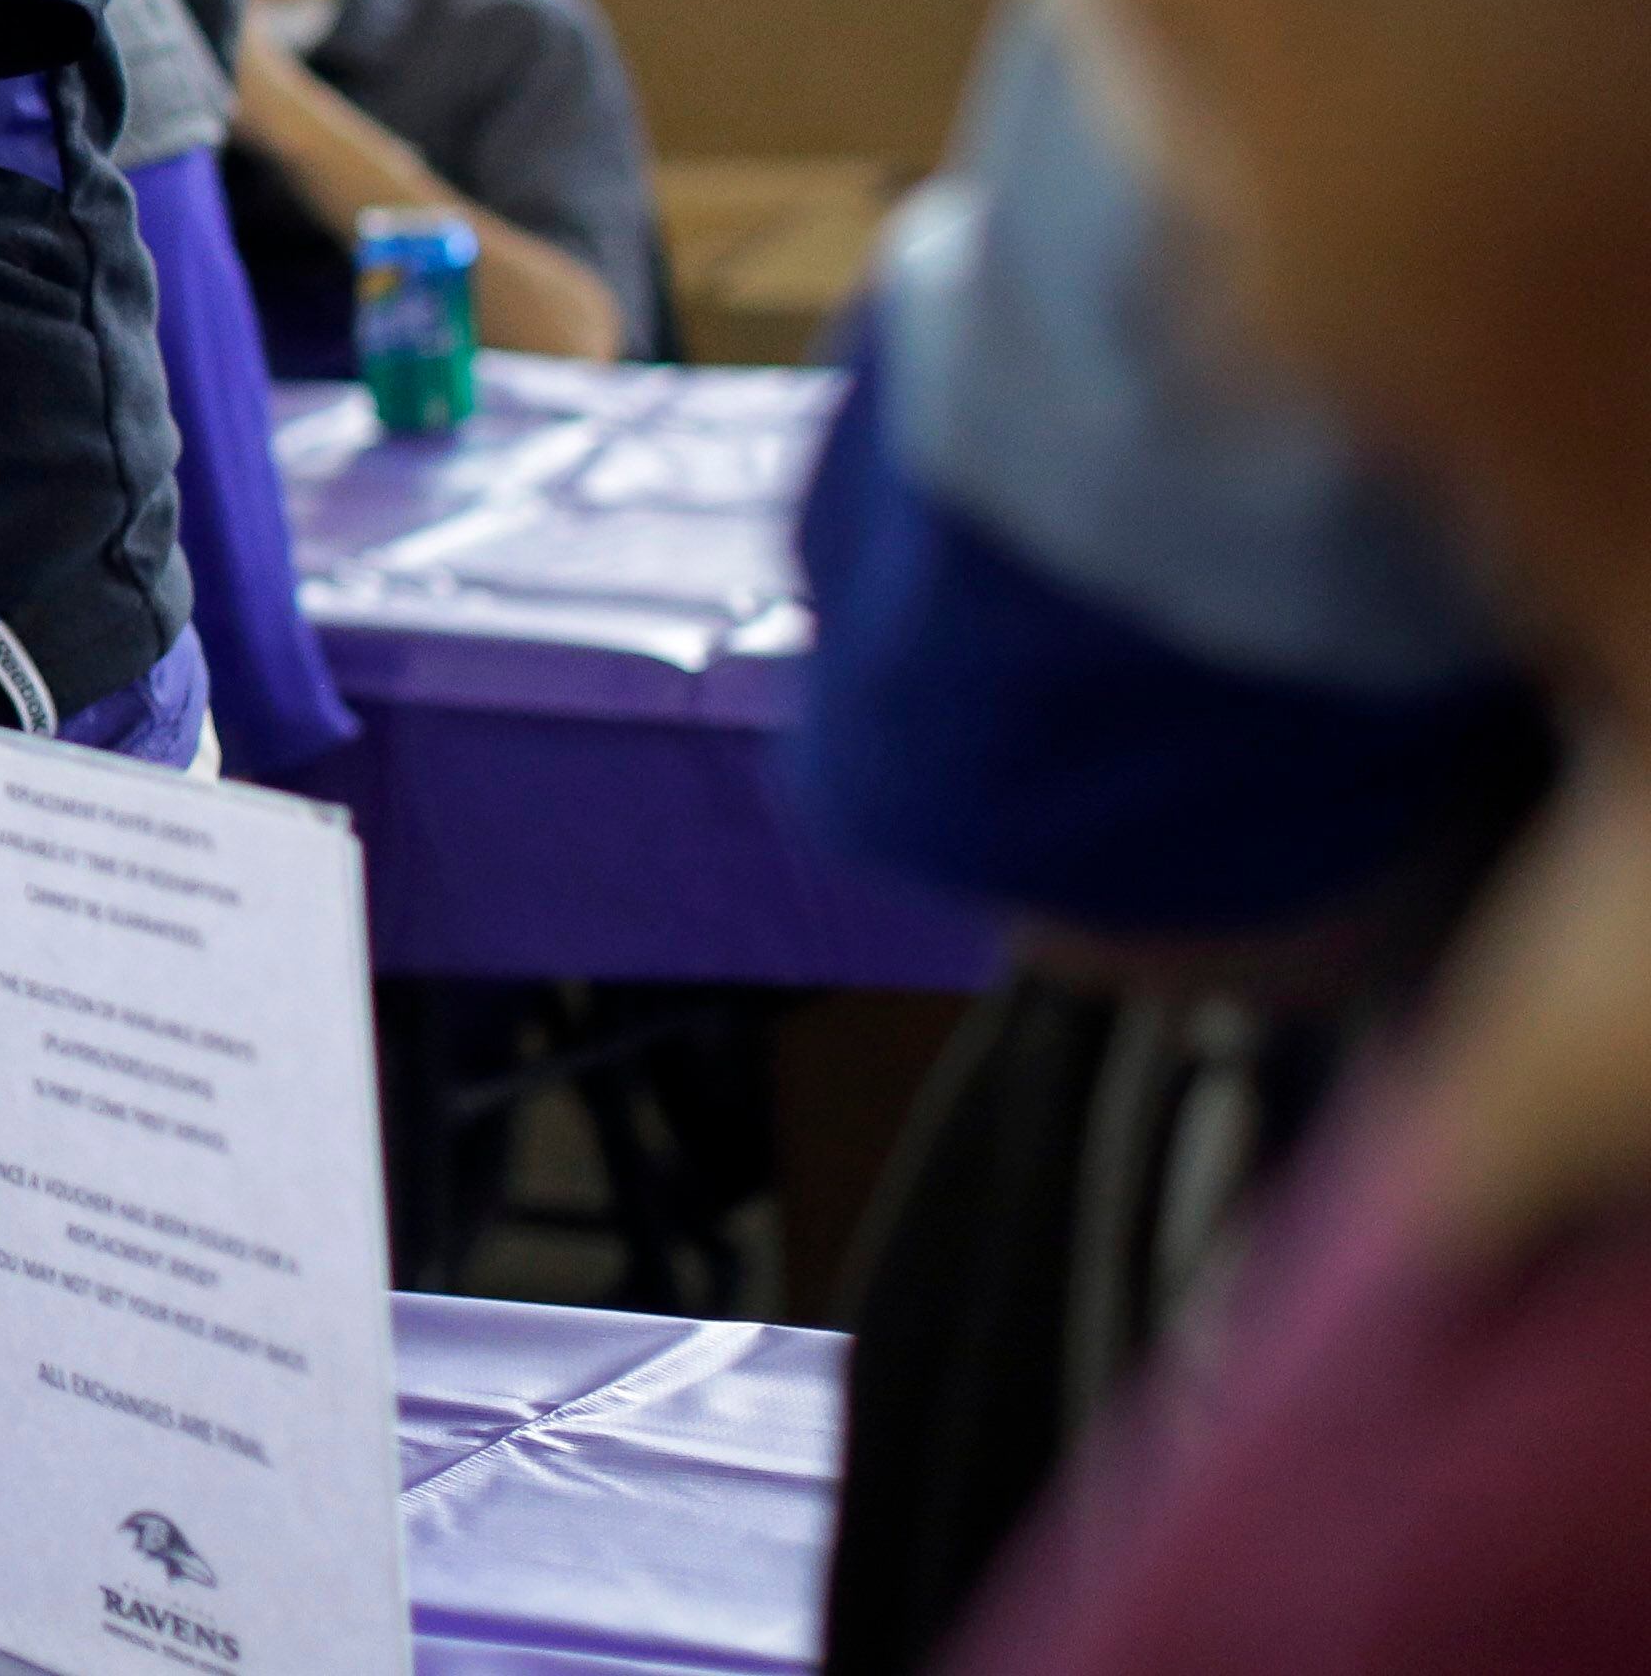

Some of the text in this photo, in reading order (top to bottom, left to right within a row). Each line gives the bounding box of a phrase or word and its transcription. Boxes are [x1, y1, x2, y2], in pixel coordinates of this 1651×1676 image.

[37, 1361, 66, 1392] ALL
[71, 1371, 176, 1429] EXCHANGES
[99, 1584, 240, 1662] RAVENS
